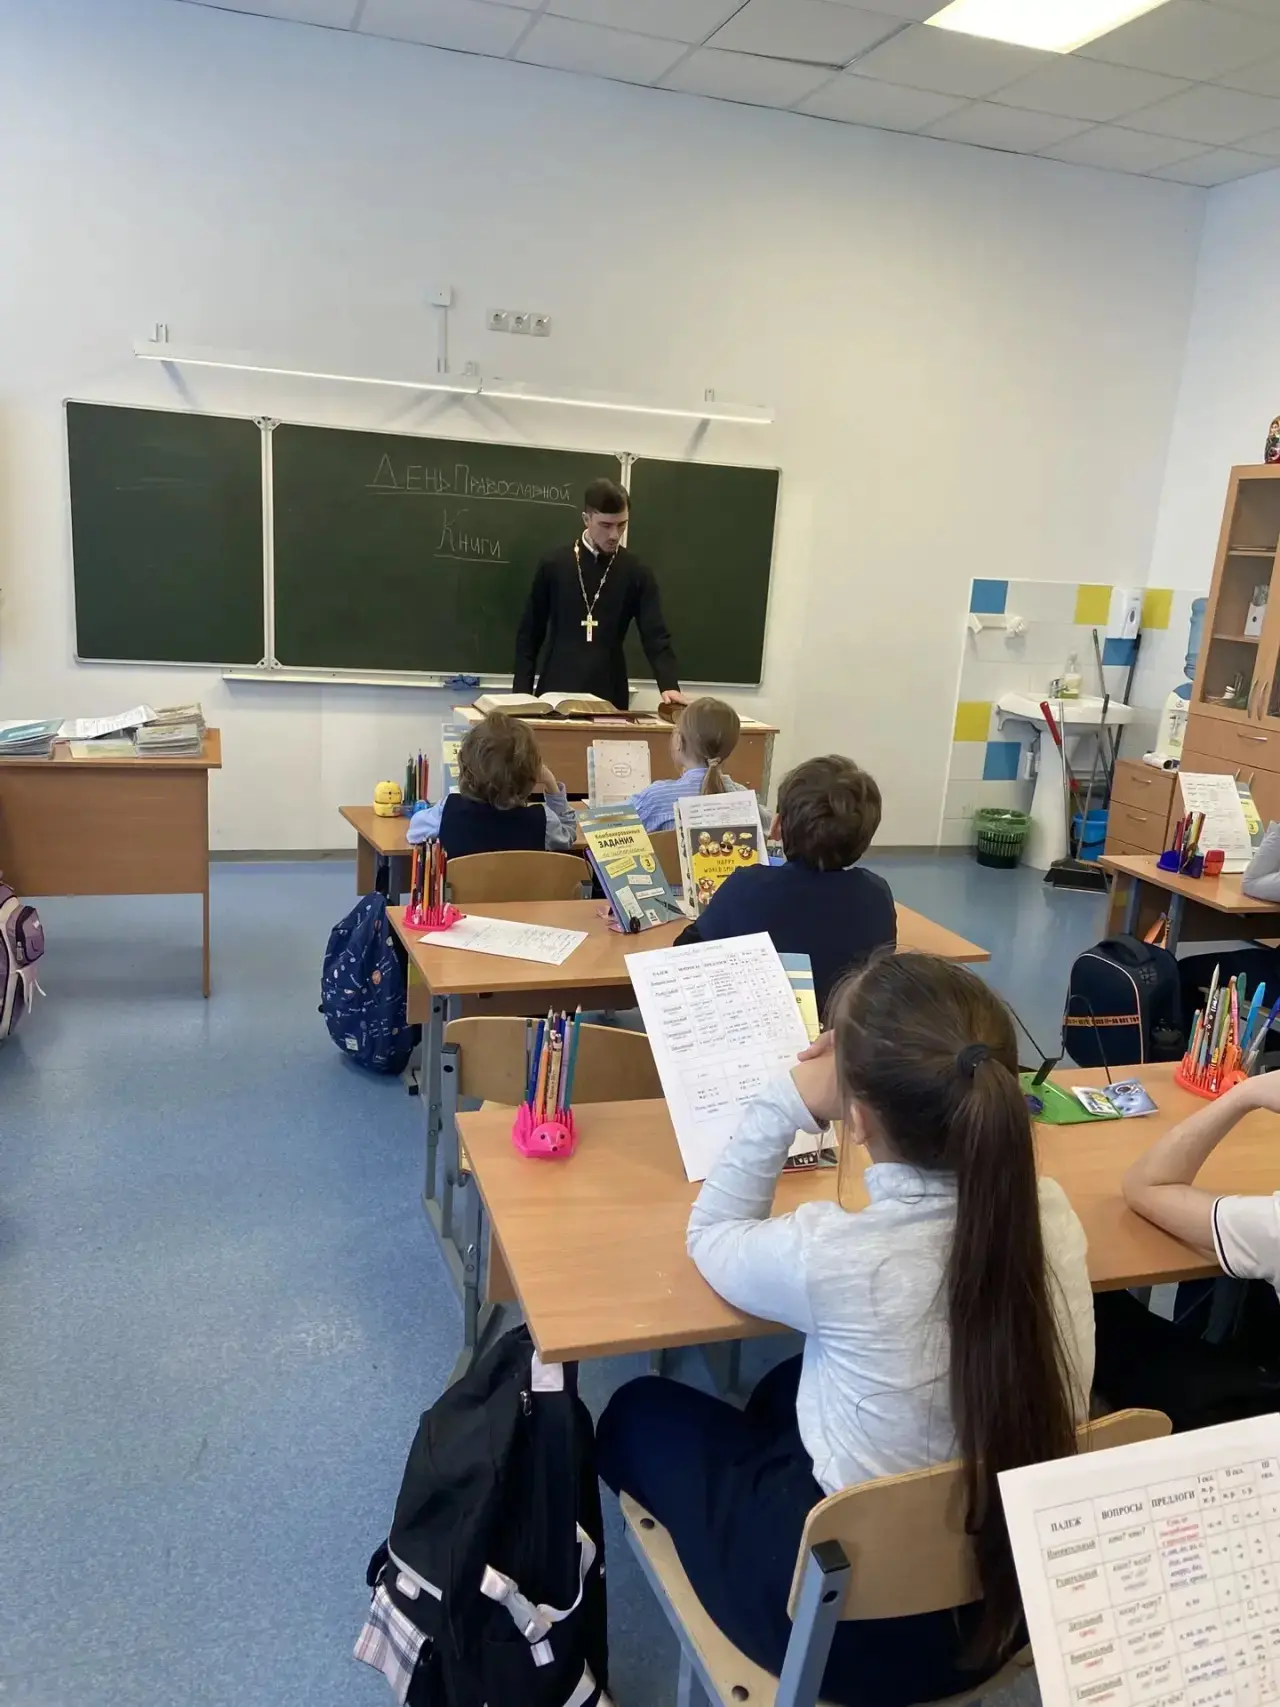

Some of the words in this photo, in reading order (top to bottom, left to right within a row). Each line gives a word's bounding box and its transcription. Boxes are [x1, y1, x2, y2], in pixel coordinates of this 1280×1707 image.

[598, 836, 635, 848] ЗАДАНИЯ
[645, 859, 651, 867] 3
[1151, 1491, 1195, 1508] ПРЕДЛОГИ
[1101, 1502, 1143, 1520] ВОПРОСЫ
[1050, 1516, 1082, 1532] ПАДЕЖ
